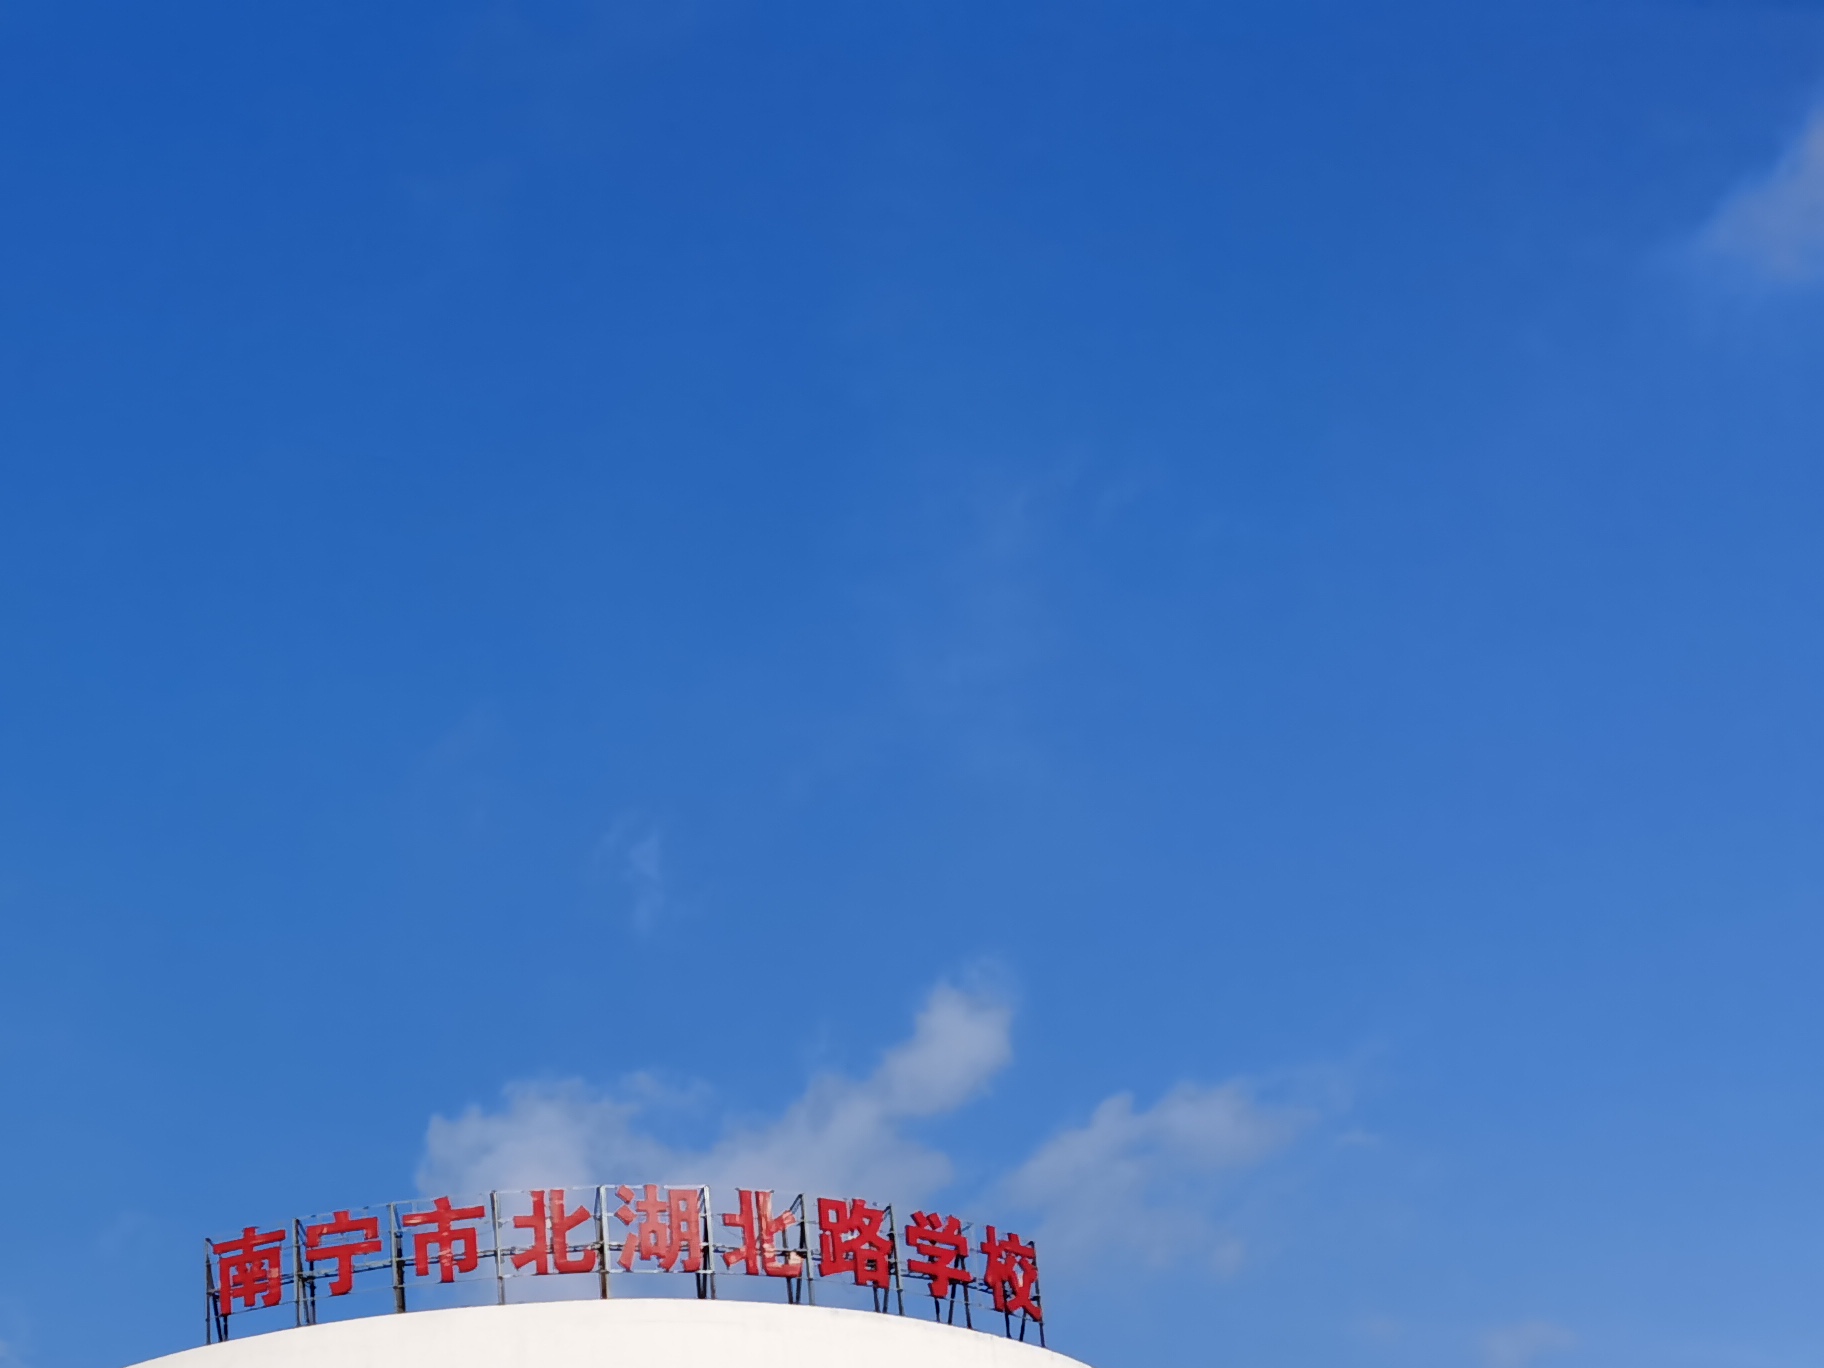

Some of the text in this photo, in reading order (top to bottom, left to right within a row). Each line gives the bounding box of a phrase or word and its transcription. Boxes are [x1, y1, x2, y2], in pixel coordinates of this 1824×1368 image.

[212, 1184, 1043, 1321] 南宁市北湖北路学校
